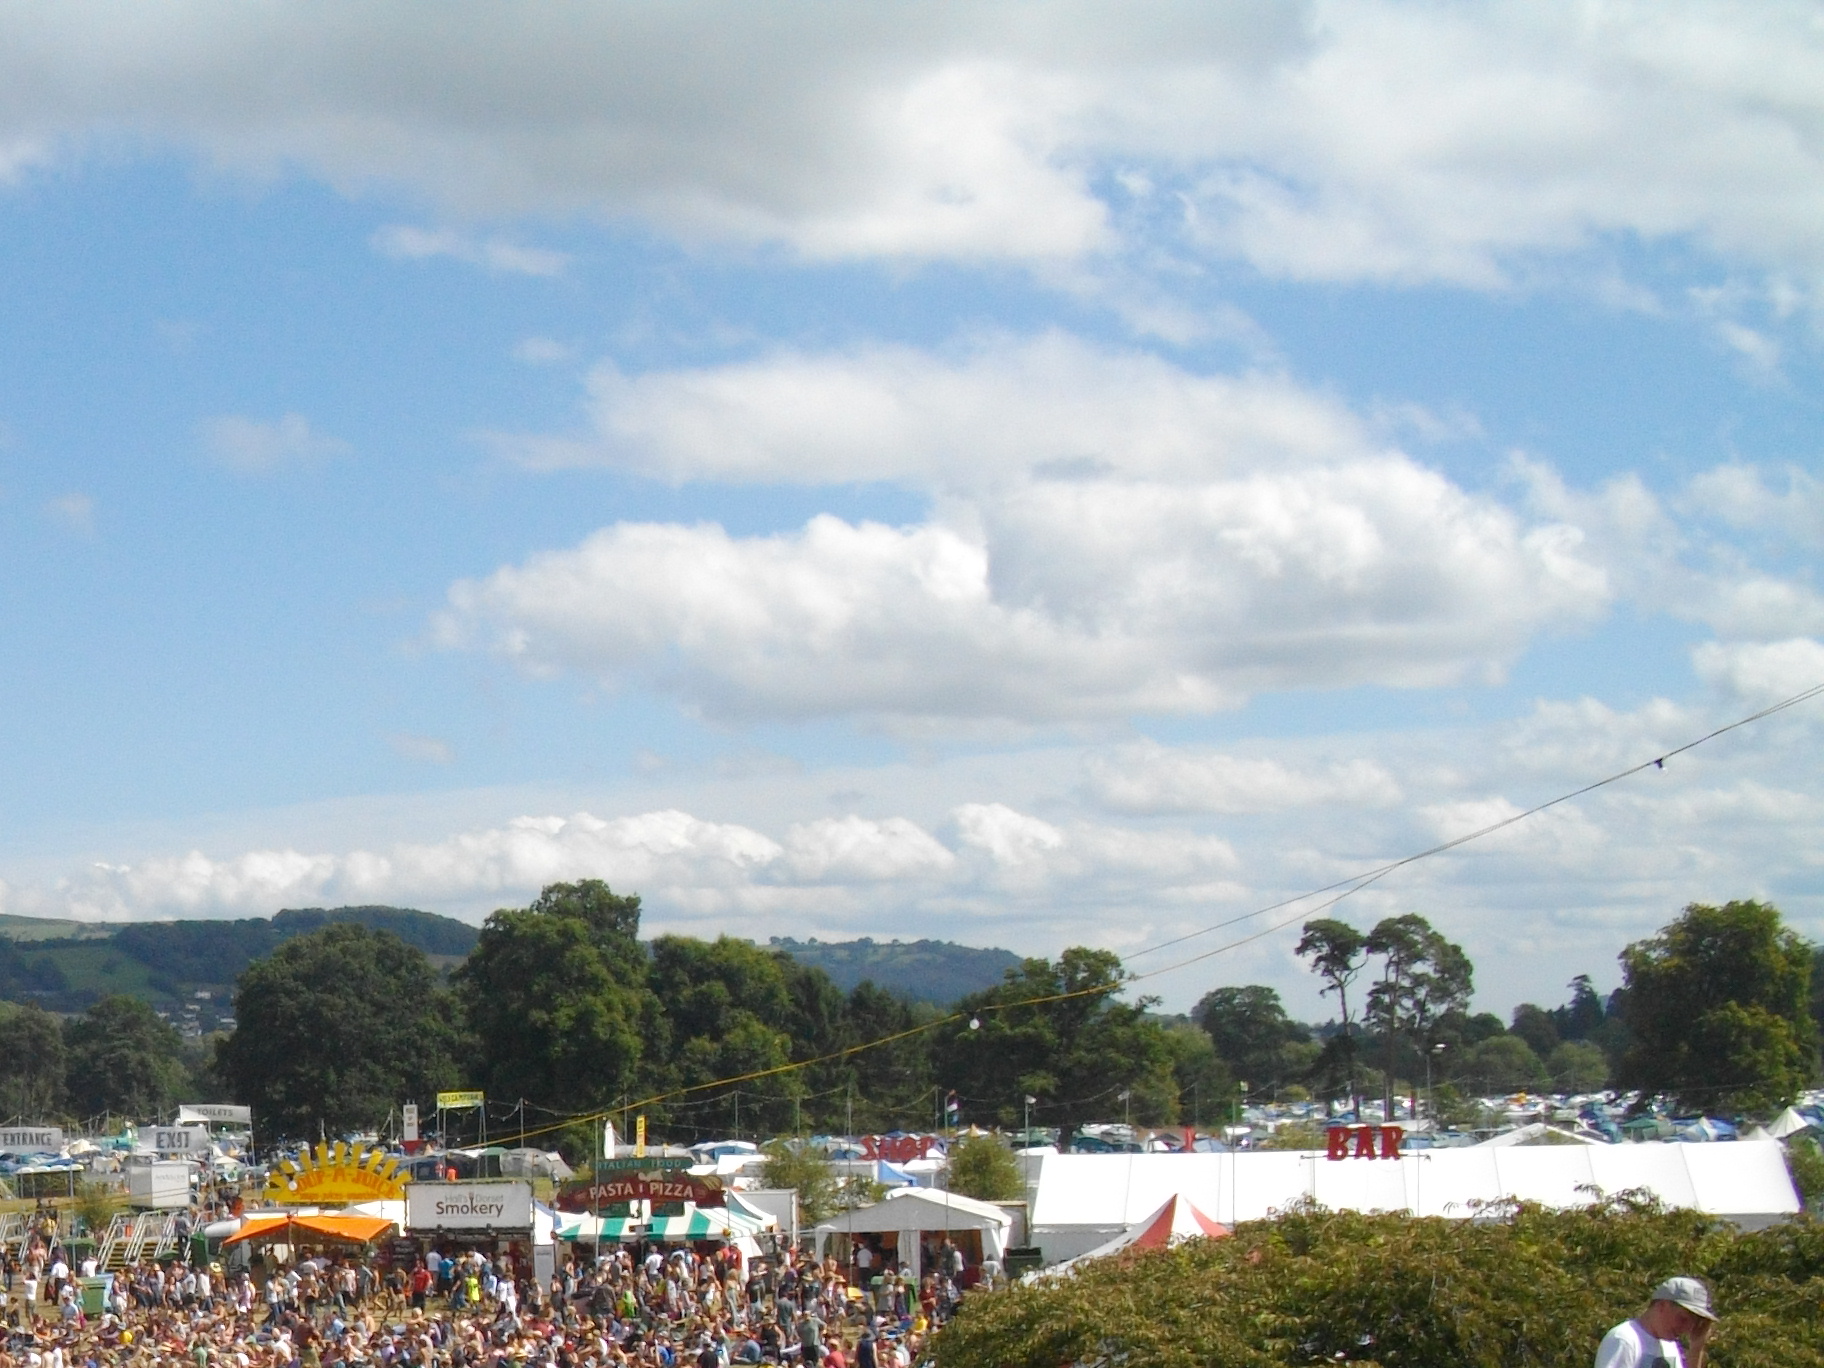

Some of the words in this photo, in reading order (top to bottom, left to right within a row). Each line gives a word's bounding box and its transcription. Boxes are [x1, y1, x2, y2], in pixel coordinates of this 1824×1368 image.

[197, 1107, 234, 1117] TOILETS
[3, 1132, 52, 1147] ENTRANCE
[156, 1131, 190, 1149] EXIT
[1326, 1125, 1403, 1161] BAR
[859, 1133, 934, 1165] SHOP
[598, 1160, 641, 1170] ITALIAN
[651, 1159, 682, 1168] FOOD
[589, 1182, 634, 1200] PASTA
[650, 1182, 694, 1198] PIZZA
[436, 1200, 504, 1218] Smokery
